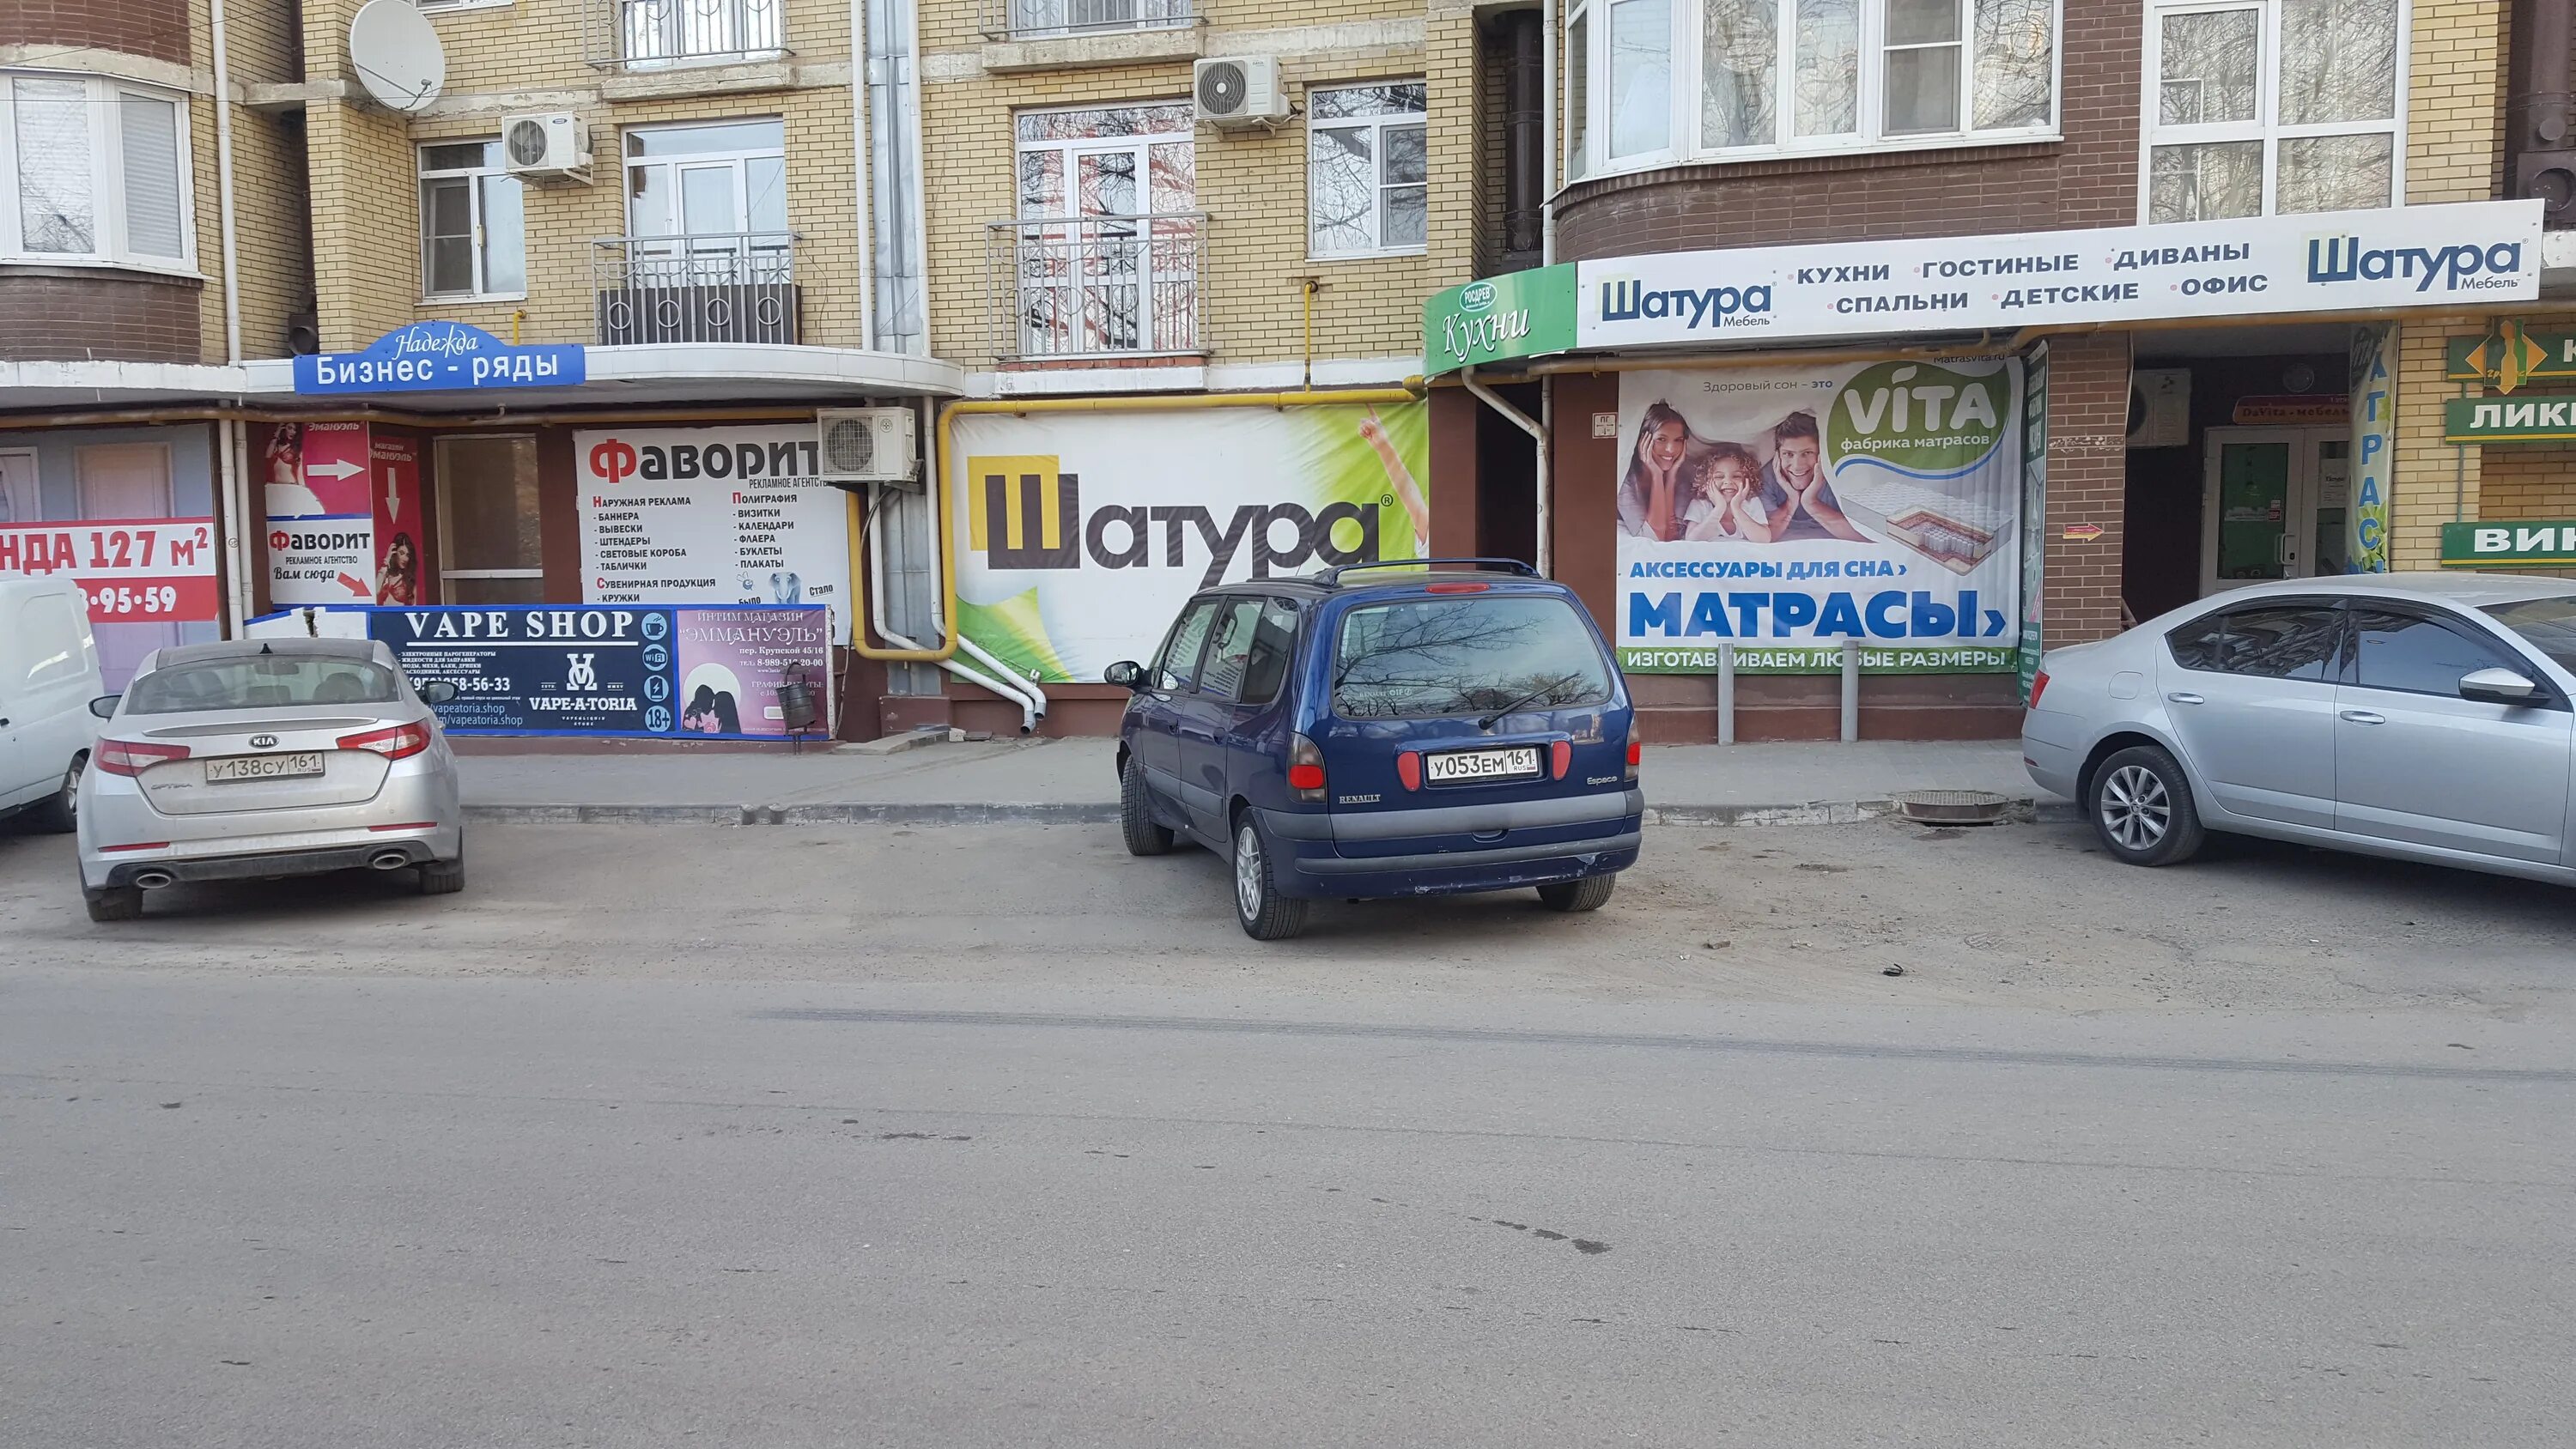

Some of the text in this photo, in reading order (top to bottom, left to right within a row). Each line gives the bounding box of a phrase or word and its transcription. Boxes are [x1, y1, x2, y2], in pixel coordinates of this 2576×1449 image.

[1797, 243, 2250, 285] КУХНИ ГОСТИНЫЕ ДИВАНЫ
[2307, 236, 2521, 293] Шатура
[2461, 276, 2518, 290] Мебель
[1464, 286, 1491, 305] РОСДРЕВ
[1836, 274, 2268, 314] СПАЛЬНИ ДЕТСКИЕ ОФИС
[1602, 280, 1771, 329] Шатура
[1723, 316, 1770, 327] Мебель
[392, 324, 478, 361] Надежда
[1443, 308, 1531, 363] Кухни
[317, 356, 434, 385] Бизнес
[472, 355, 558, 385] ряды
[1704, 379, 1771, 394] Здоровый
[1774, 381, 1797, 391] сон
[1811, 379, 1832, 389] это
[2470, 403, 2576, 428] ЛИК
[1840, 436, 1990, 454] фабрика матрасов
[589, 438, 819, 483] Фаворит
[749, 477, 791, 488] РЕКЛАМНОЕ
[592, 496, 691, 508] НАРУЖНАЯ РЕКЛАМА
[732, 492, 798, 505] ПОЛИГРАФИЯ
[598, 512, 640, 522] БАННЕРА
[738, 508, 781, 518] ВИЗИТКИ
[599, 524, 643, 535] ВЫВЕСКИ
[738, 521, 794, 531] КАЛЕНДАРИ
[985, 473, 1380, 591] Шатура
[269, 530, 370, 551] Фаворит
[600, 537, 651, 547] ШТЕНДЕРЫ
[739, 534, 775, 543] ФЛАЕРА
[89, 530, 156, 568] 127
[600, 548, 687, 559] СВЕТОВЫЕ КОРОБА
[739, 547, 782, 556] БУКЛЕТЫ
[286, 555, 358, 566] РЕКЛАМНОЕ АГЕНТСТВО
[600, 561, 647, 572] ТАБЛИЧКИ
[740, 559, 784, 569] ПЛАКАТЫ
[274, 566, 335, 583] Вам сюда
[1630, 561, 1891, 581] АКСЕССУАРЫ ДЛЯ СНА
[597, 577, 716, 590] СУВЕНИРНАЯ ПРОДУКЦИЯ
[809, 584, 834, 597] Стало
[602, 593, 640, 603] КРУЖКИ
[697, 612, 804, 623] ИНТИМ МАГАЗИН
[1629, 591, 1978, 638] МАТРАСЫ
[404, 610, 633, 638] VAPE SHOP
[758, 646, 800, 656] Крупской
[802, 646, 823, 655] 45/16
[1627, 651, 2006, 667] ИЗГОТАВИВАЕМ ЛЮЫЕ РАЗМЕРЫ
[529, 697, 637, 711] VAPE-A-TORIA
[648, 709, 670, 728] 18+
[252, 737, 274, 746] KIA
[289, 755, 318, 769] 161
[1433, 749, 1533, 777] У053ЕМ 161
[1586, 774, 1618, 785] Espace
[1339, 794, 1381, 804] RENAULT
